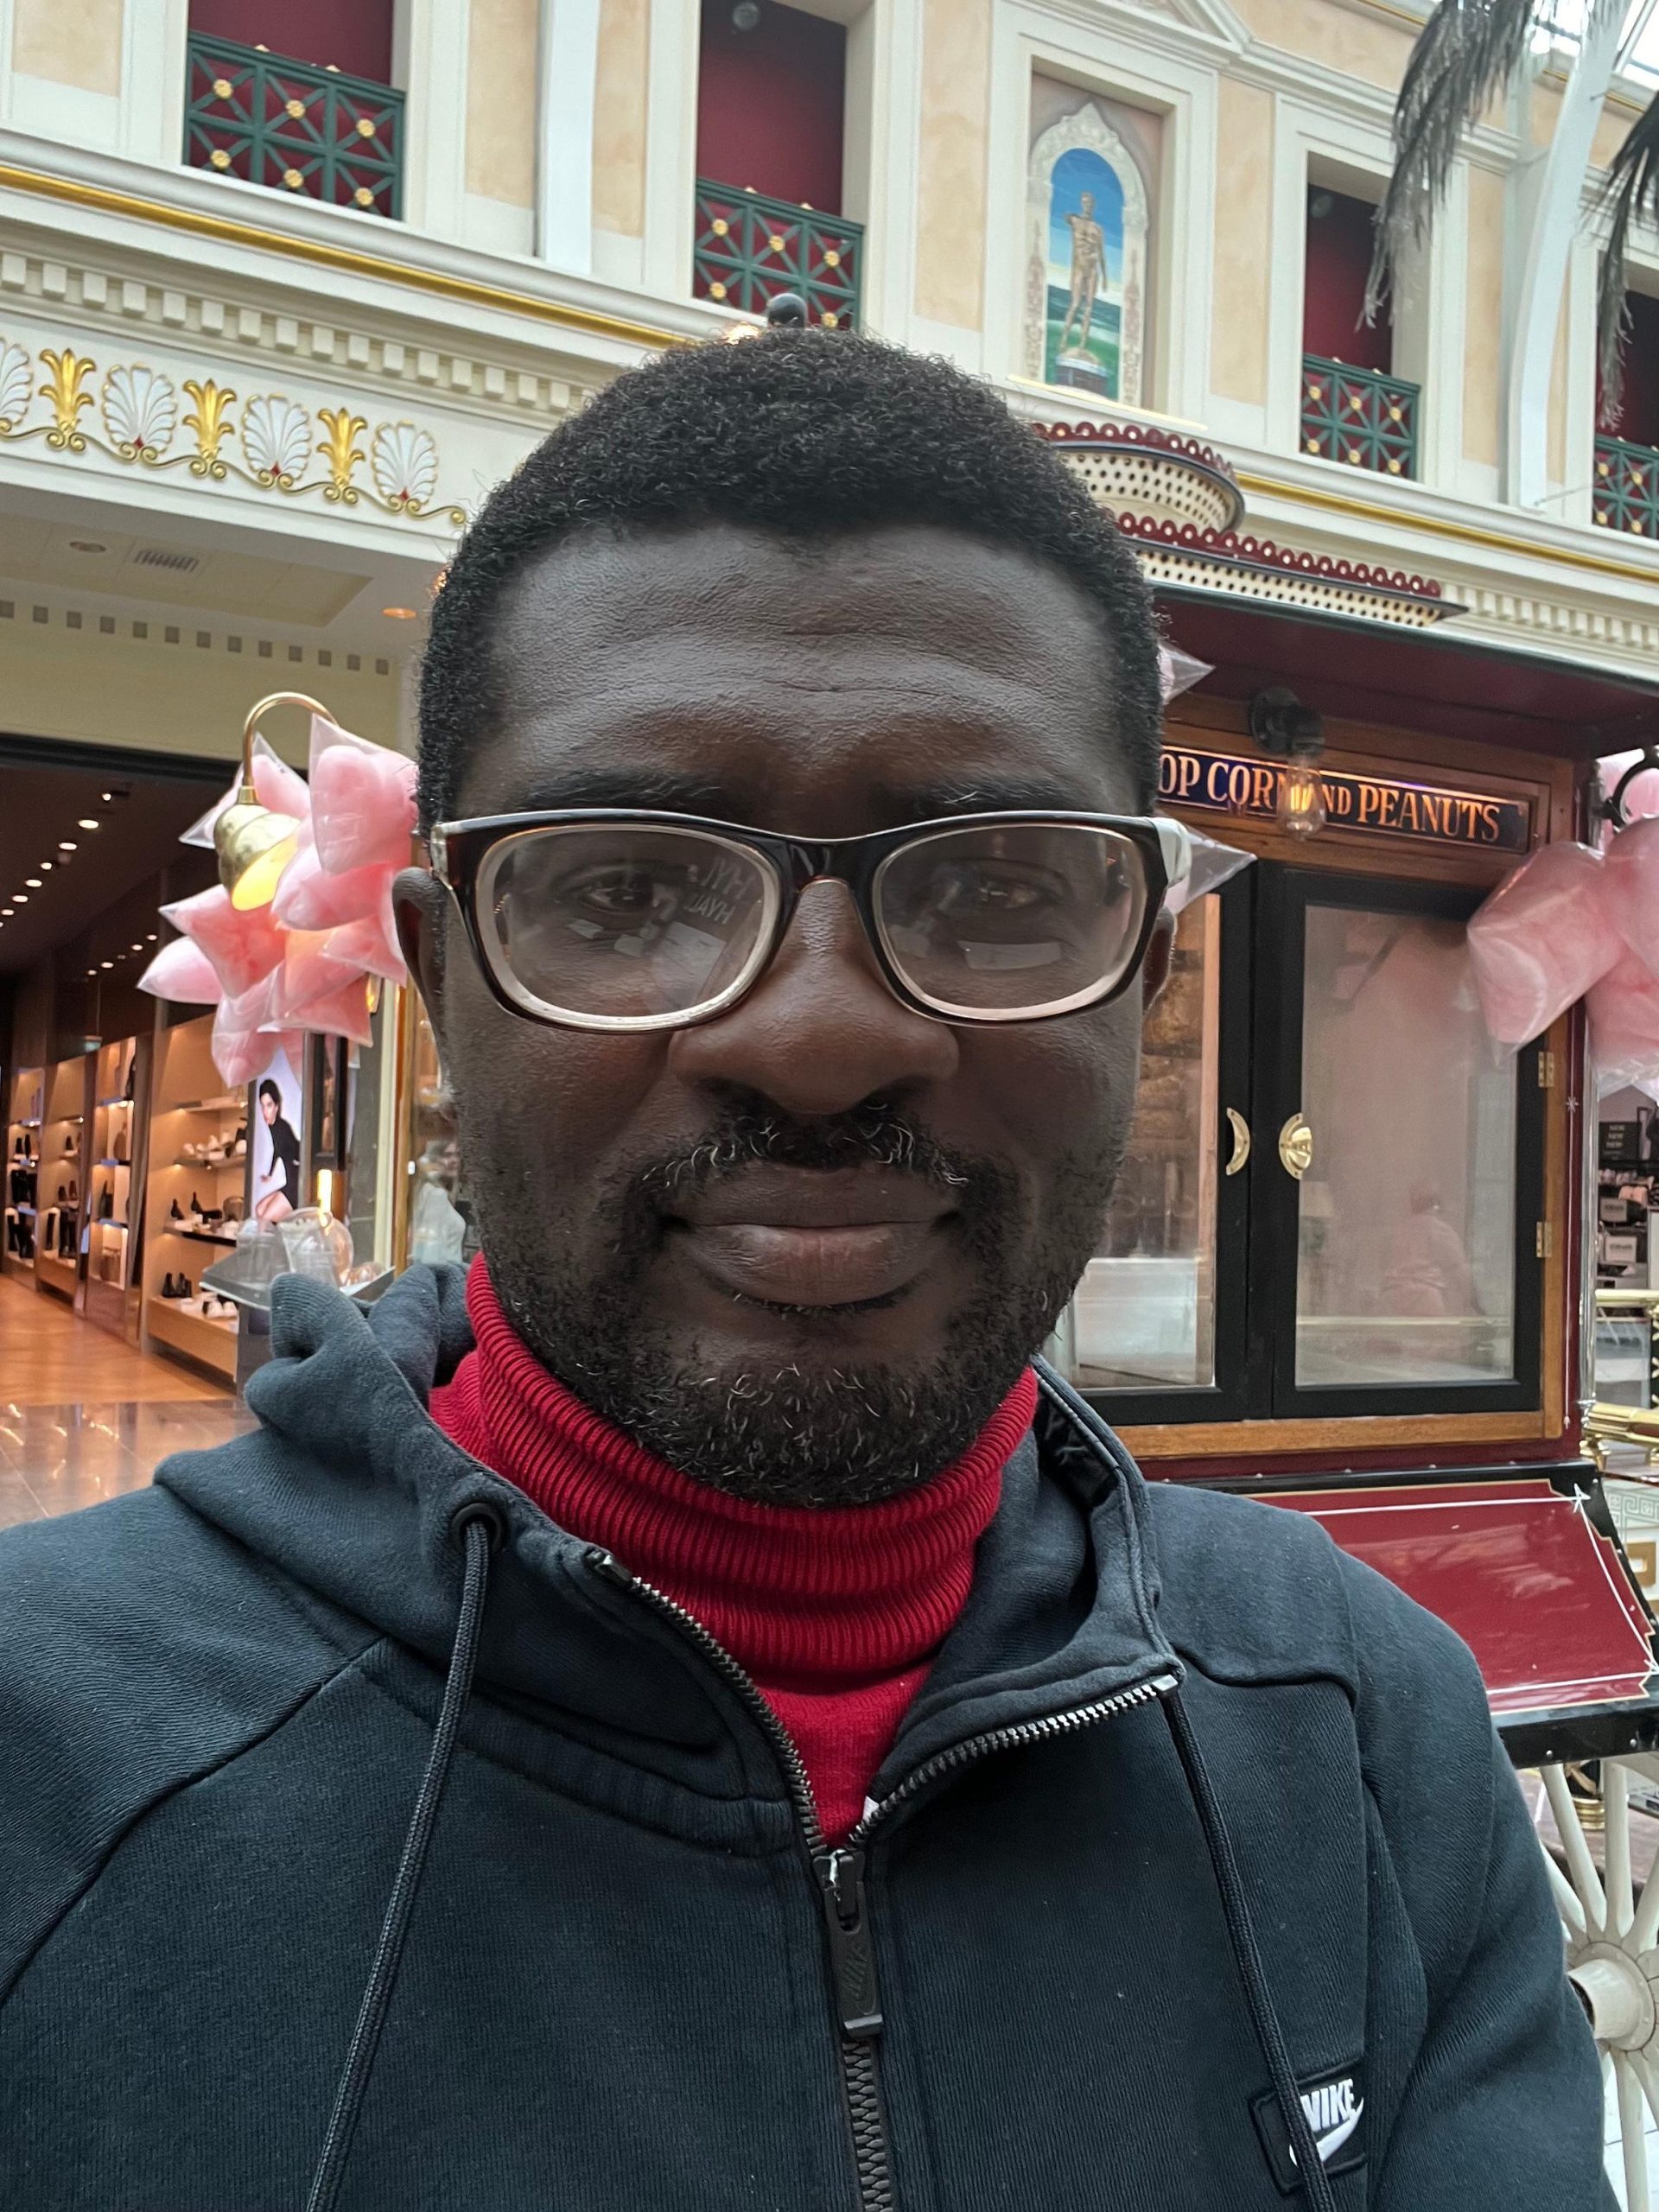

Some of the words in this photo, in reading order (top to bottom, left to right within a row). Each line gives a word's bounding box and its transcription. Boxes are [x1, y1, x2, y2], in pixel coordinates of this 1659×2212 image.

[1157, 753, 1201, 797] OP
[1321, 783, 1352, 816] ND
[1356, 783, 1501, 843] PEANUTS
[1300, 2078, 1355, 2133] NIKE
